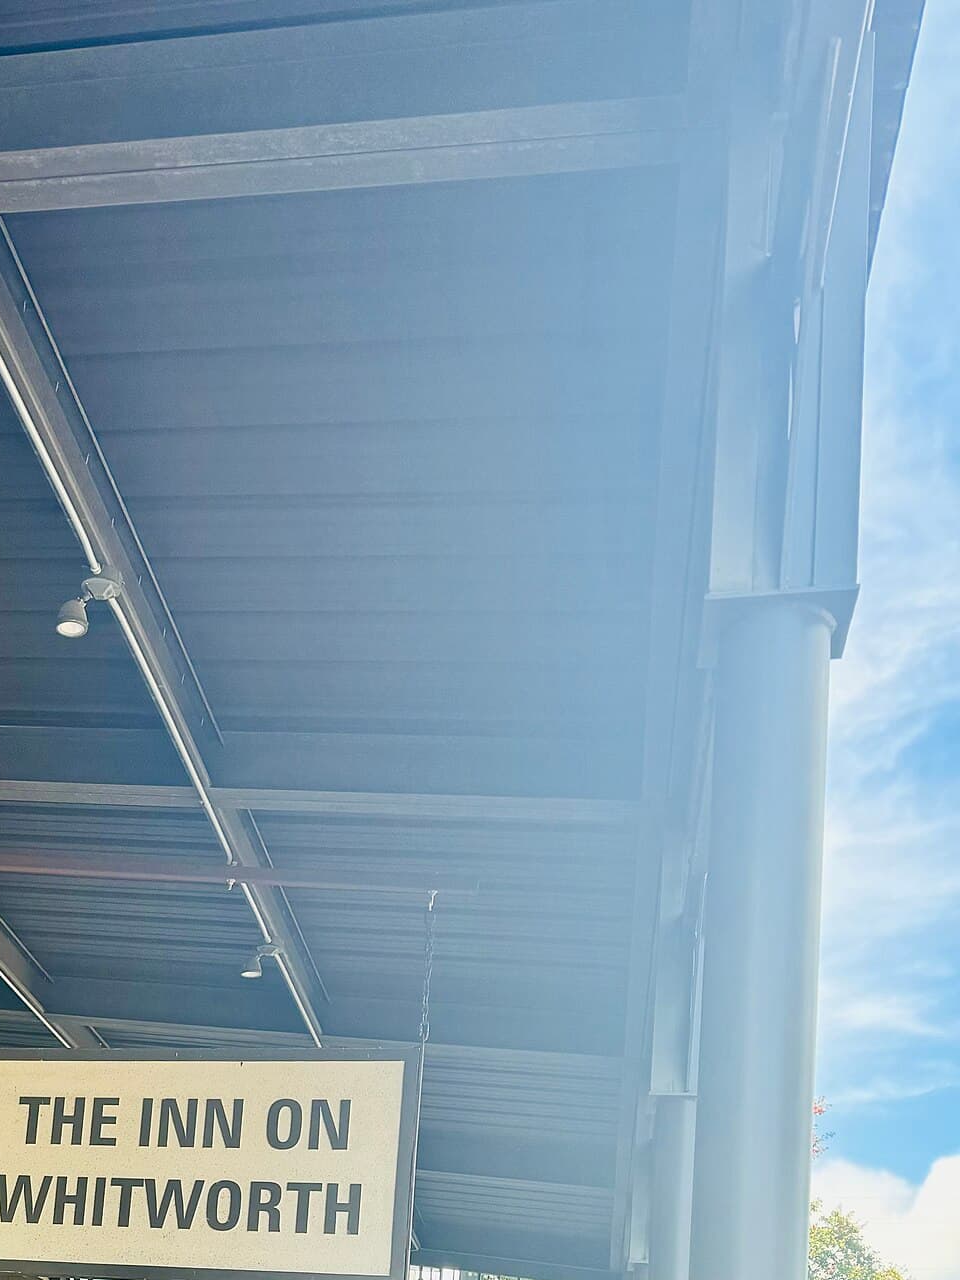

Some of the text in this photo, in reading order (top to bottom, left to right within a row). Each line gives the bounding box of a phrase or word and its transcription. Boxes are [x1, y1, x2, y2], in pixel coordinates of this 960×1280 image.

[18, 1096, 352, 1151] THE INN ON
